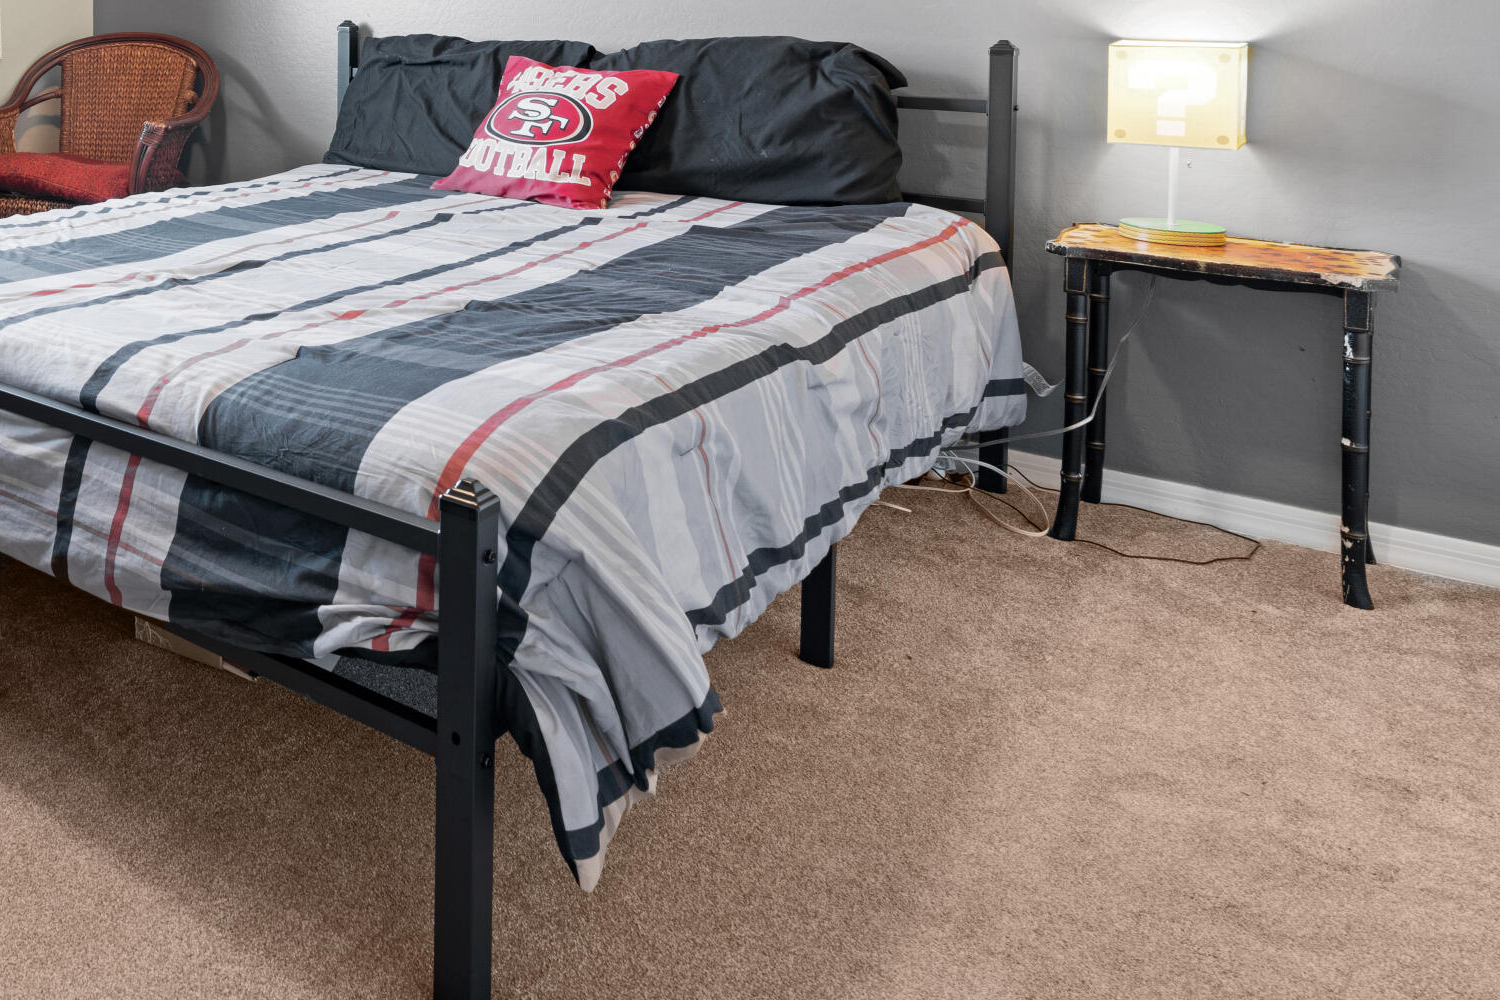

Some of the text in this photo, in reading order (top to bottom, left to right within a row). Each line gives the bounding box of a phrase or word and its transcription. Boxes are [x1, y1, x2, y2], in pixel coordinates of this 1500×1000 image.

[507, 65, 629, 110] 49ERS
[508, 96, 570, 139] SF
[459, 138, 592, 187] OOTBALL
